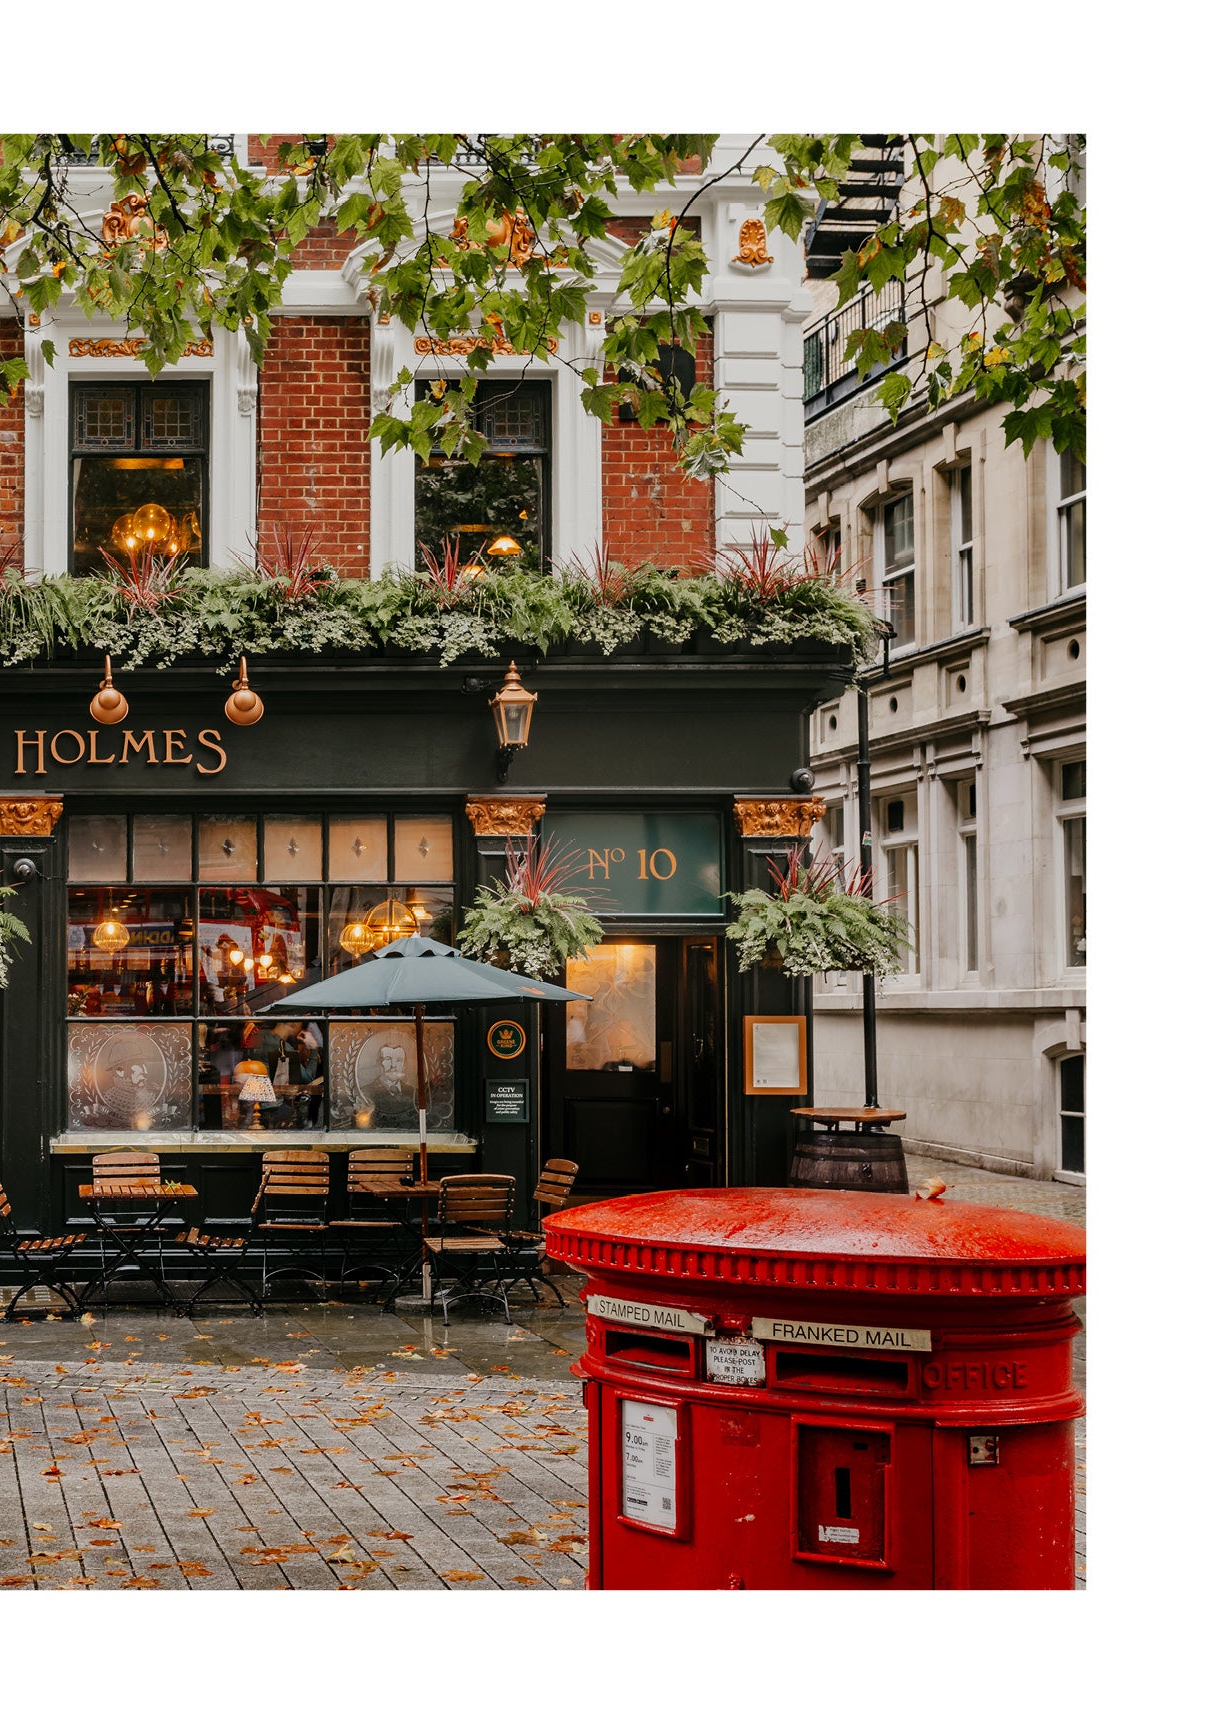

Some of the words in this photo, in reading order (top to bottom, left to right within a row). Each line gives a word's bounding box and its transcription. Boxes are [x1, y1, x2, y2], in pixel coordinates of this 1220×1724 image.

[13, 729, 228, 775] HOLMES
[636, 848, 678, 881] 10
[599, 1299, 650, 1322] STAMPED
[654, 1310, 685, 1328] MAIL
[772, 1322, 859, 1344] FRANKED
[865, 1330, 912, 1347] MAIL
[710, 1346, 718, 1354] TO
[718, 1347, 738, 1356] AVOID
[740, 1349, 761, 1357] DELAY
[713, 1355, 736, 1365] PLEASE
[738, 1358, 756, 1366] POST
[713, 1373, 735, 1382] PROPER
[731, 1366, 745, 1374] THE
[922, 1360, 1029, 1391] OFFICE
